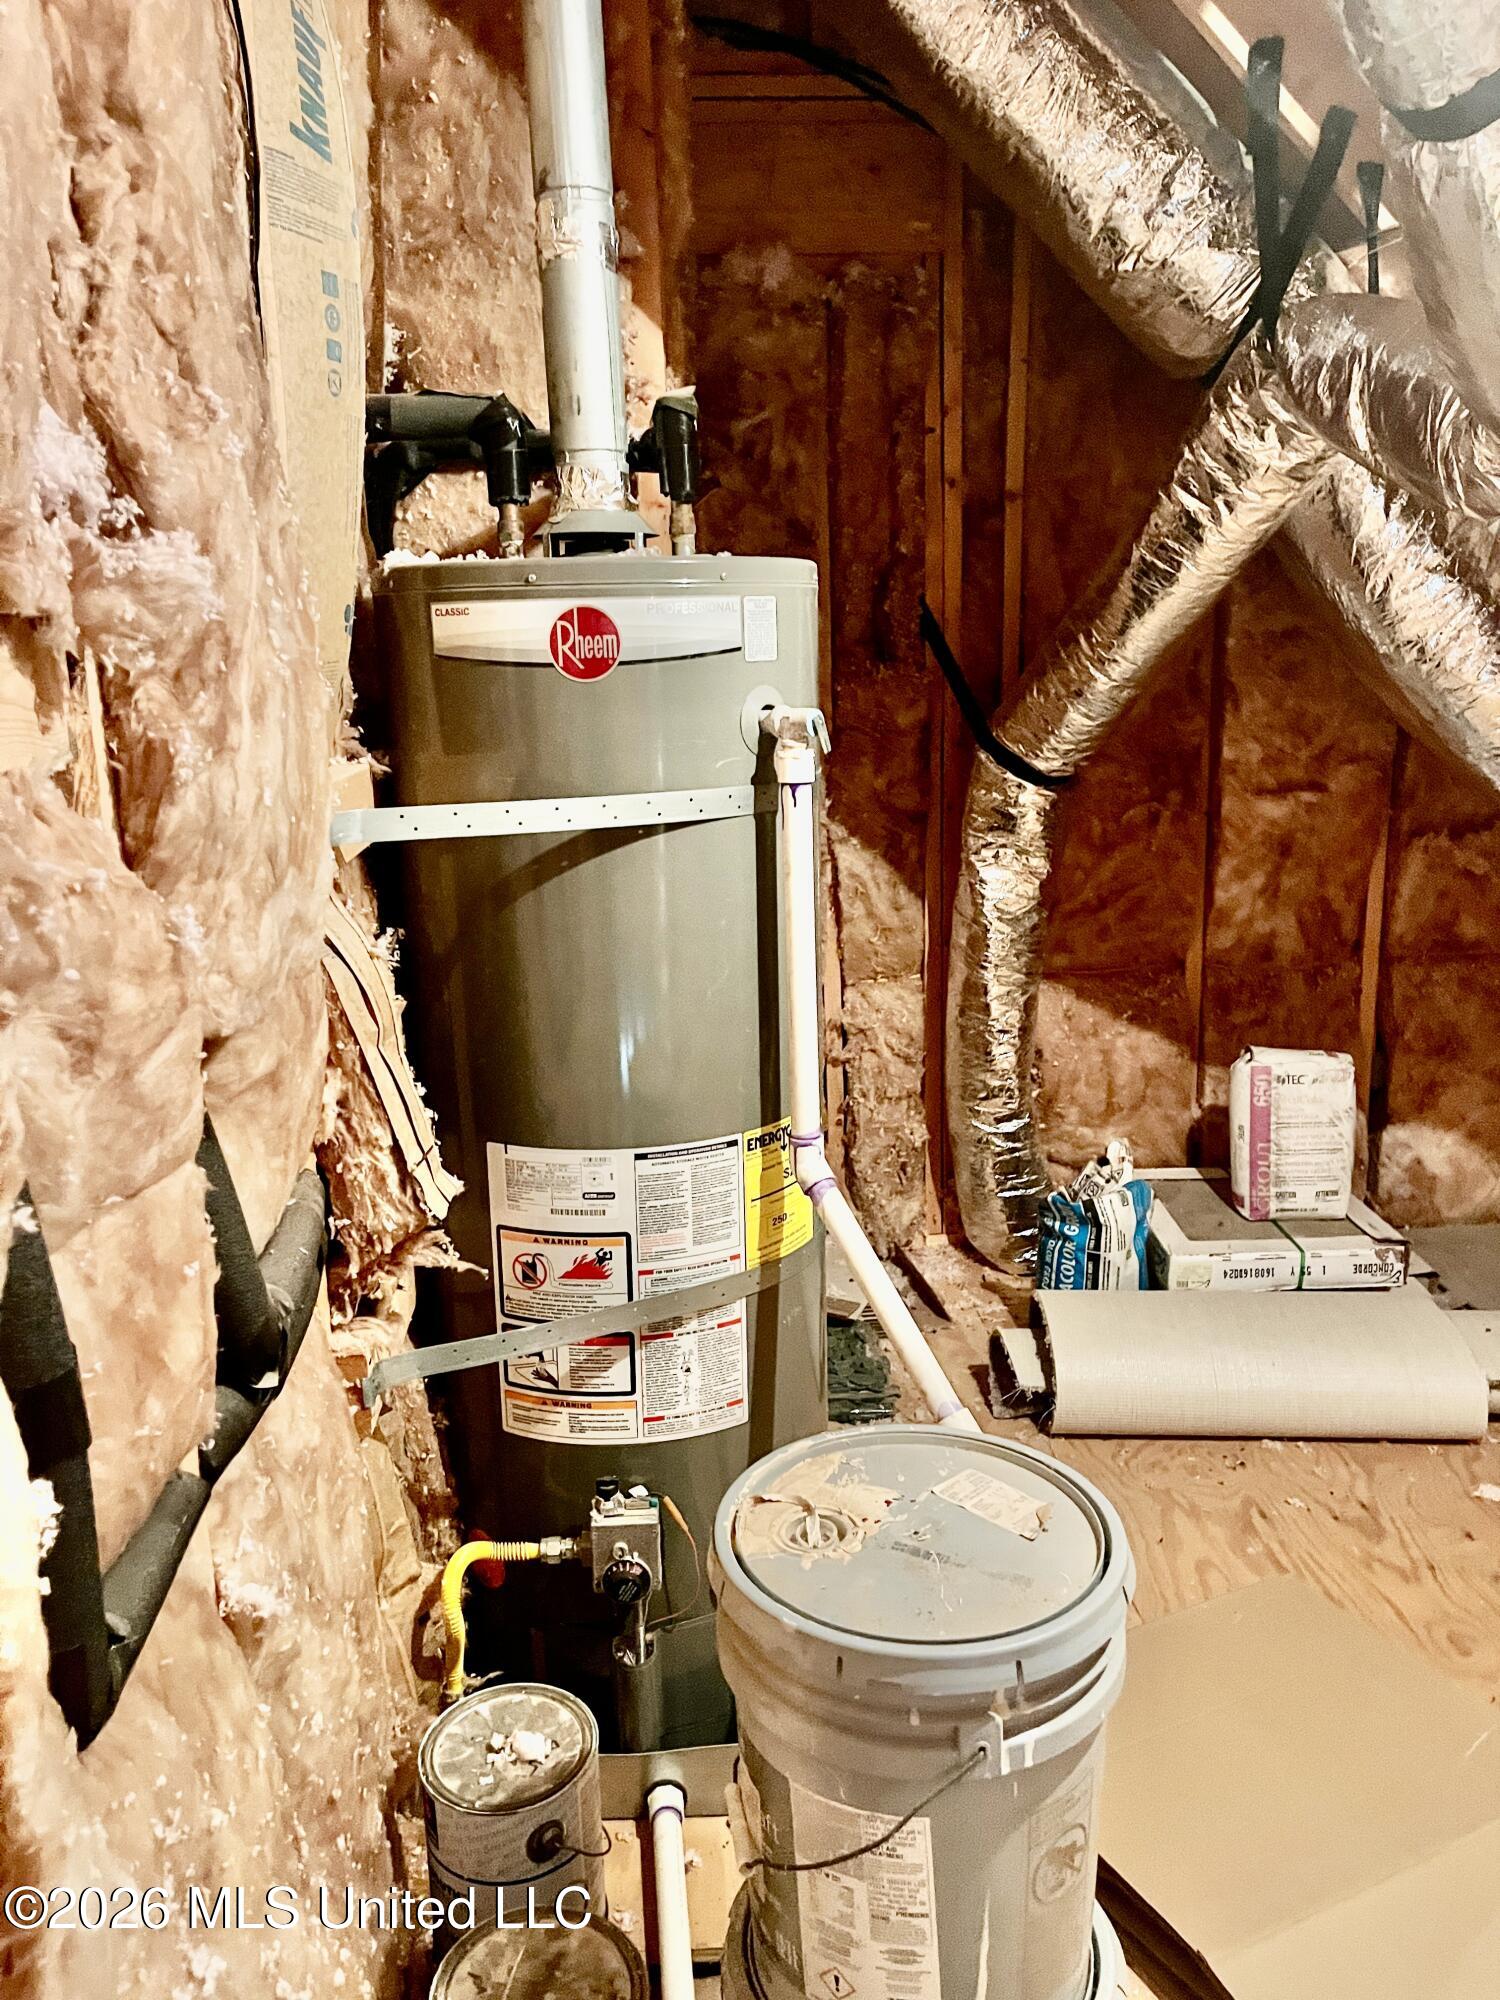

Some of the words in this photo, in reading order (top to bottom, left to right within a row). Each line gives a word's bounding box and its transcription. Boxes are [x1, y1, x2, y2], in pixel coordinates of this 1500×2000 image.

[289, 0, 332, 164] KNAUF
[434, 607, 470, 617] CLASSIC
[646, 602, 737, 614] PROFESSIONAL
[556, 607, 617, 669] Rheem
[1253, 1073, 1271, 1107] 650
[772, 1212, 788, 1226] 250
[543, 1238, 589, 1246] WARNING
[1353, 1263, 1395, 1275] CONCORDE
[552, 1400, 592, 1409] WARNING
